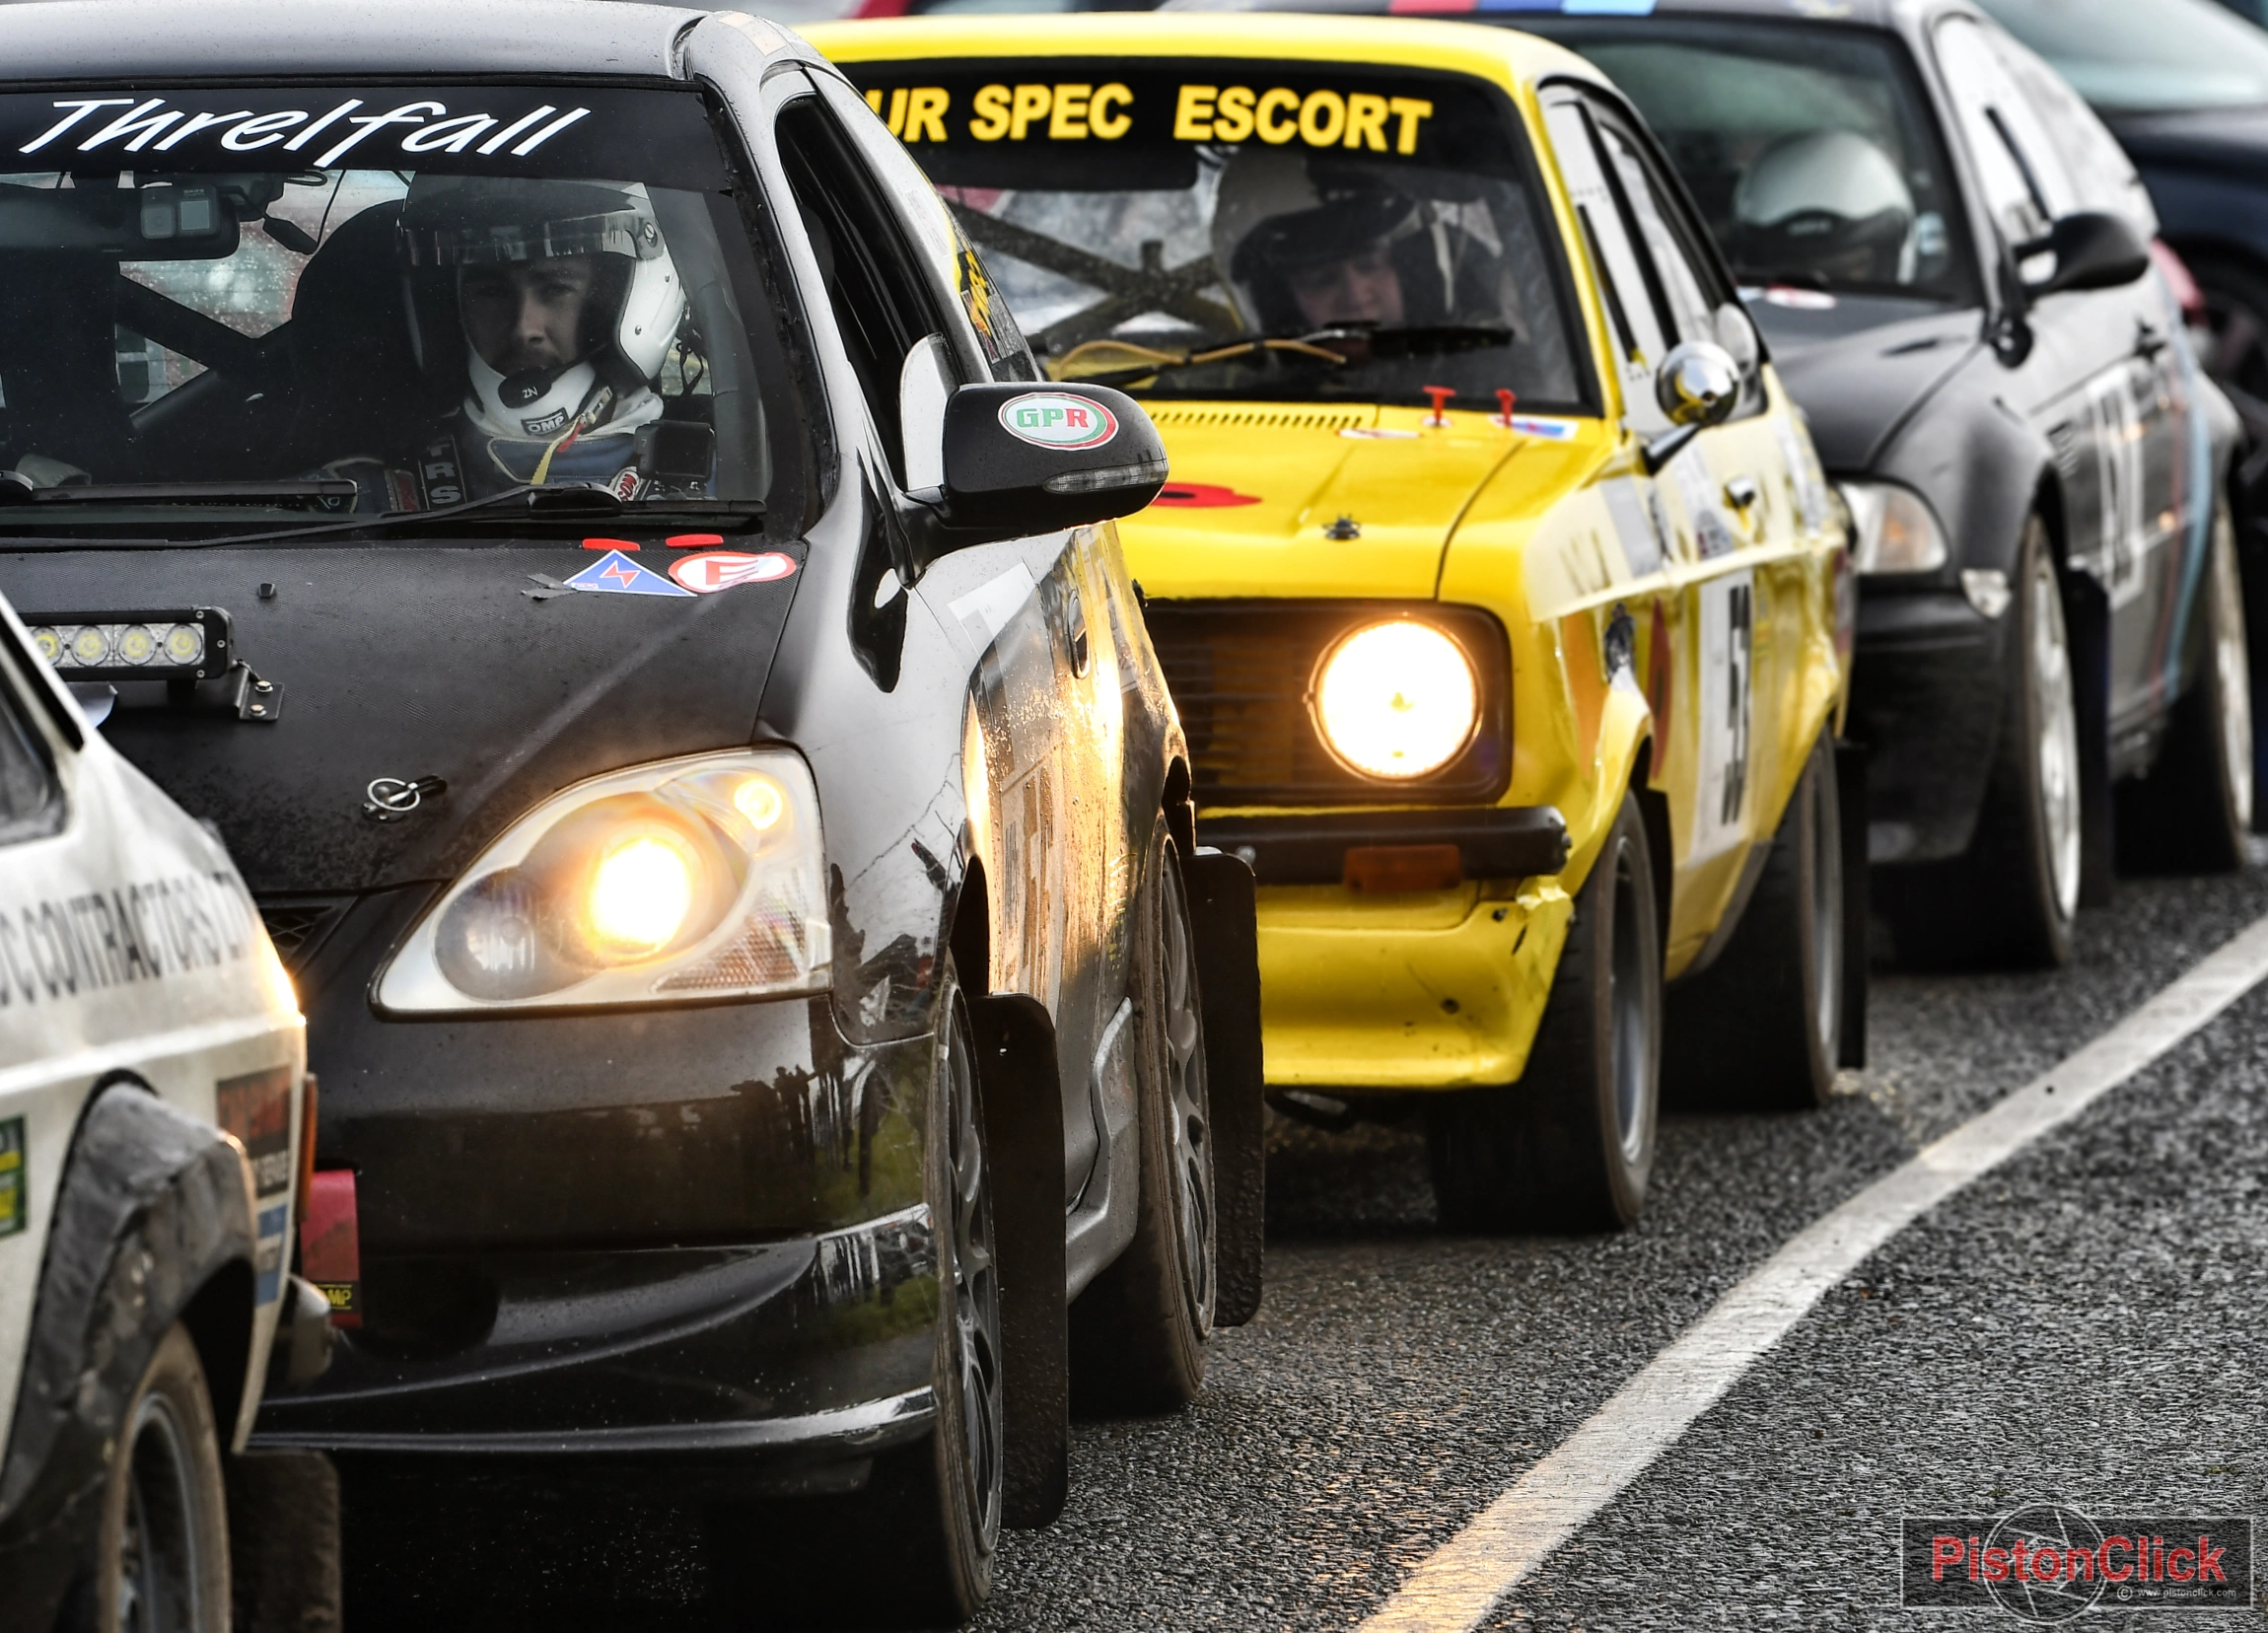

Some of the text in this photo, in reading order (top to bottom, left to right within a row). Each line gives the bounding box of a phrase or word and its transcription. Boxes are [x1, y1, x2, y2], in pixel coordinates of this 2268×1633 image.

[18, 98, 592, 169] Threlfall
[968, 83, 1134, 141] SPEC
[1172, 85, 1434, 156] ESCORT
[528, 415, 566, 434] OMP
[1016, 407, 1090, 429] GPR
[425, 443, 461, 505] TRS
[315, 1288, 352, 1306] MP
